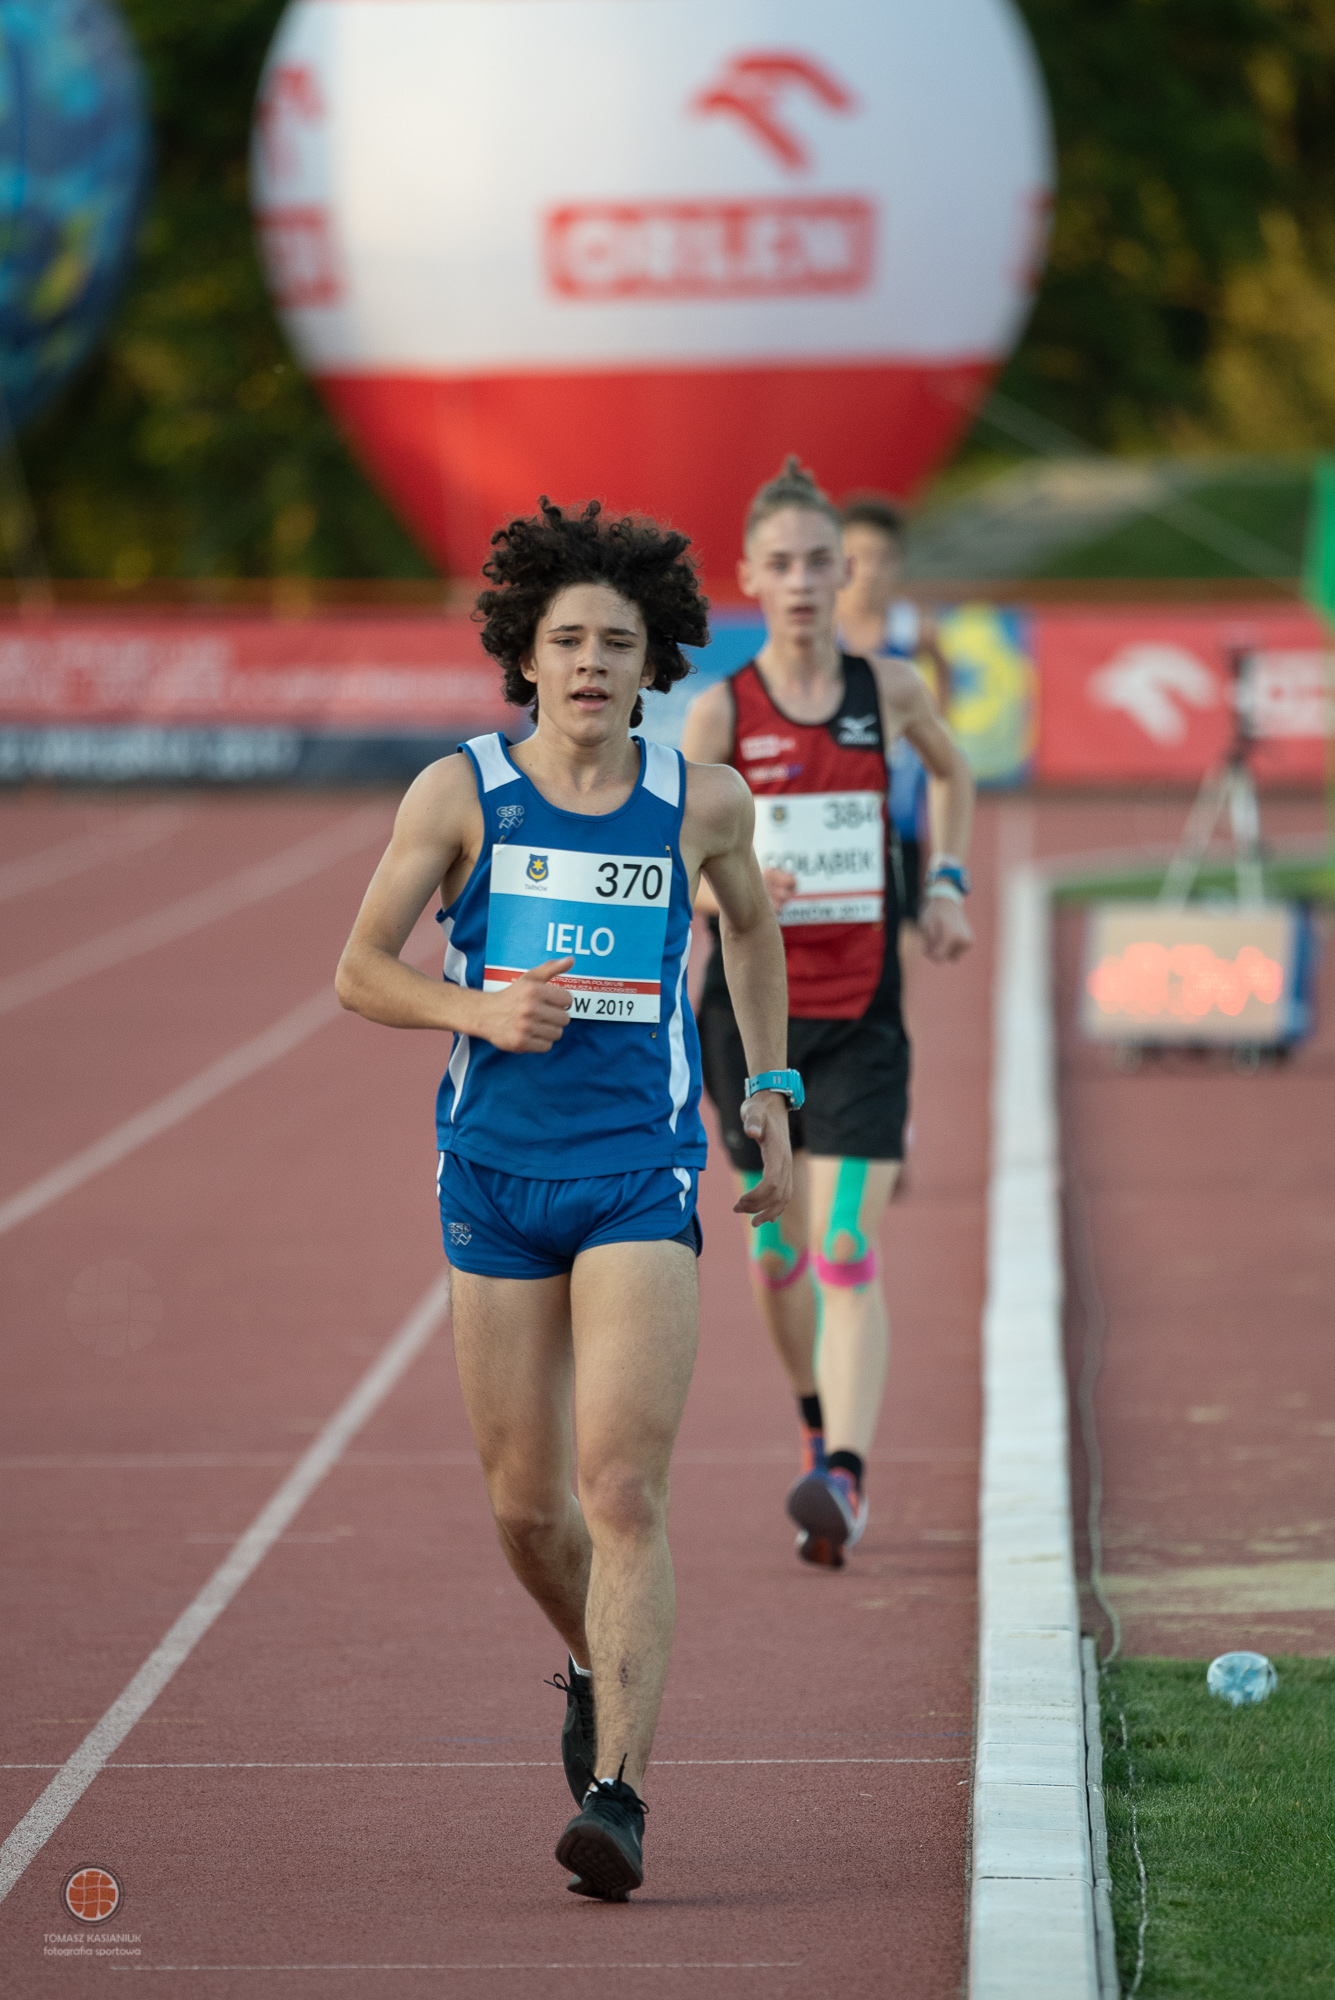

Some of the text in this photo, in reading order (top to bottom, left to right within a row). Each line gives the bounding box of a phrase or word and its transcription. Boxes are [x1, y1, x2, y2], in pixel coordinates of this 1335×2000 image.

[595, 862, 663, 900] 370
[546, 922, 615, 957] IELO
[595, 999, 635, 1016] 2019
